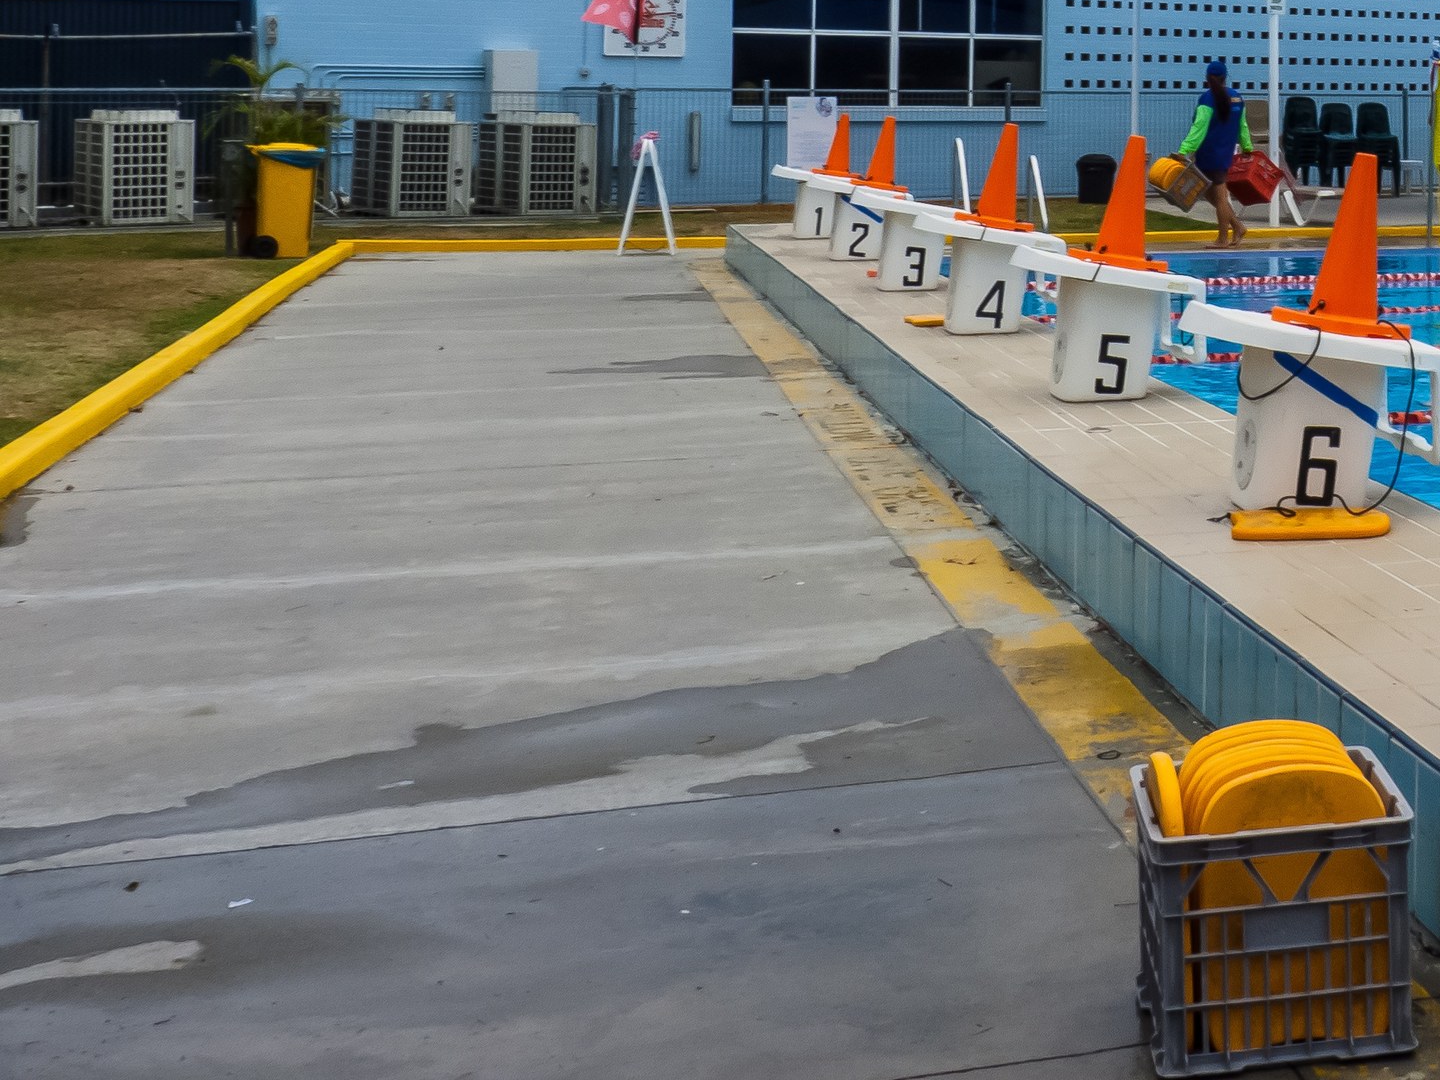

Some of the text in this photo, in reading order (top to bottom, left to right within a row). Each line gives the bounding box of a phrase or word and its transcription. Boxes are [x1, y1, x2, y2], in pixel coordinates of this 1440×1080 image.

[814, 206, 823, 236] 1
[848, 222, 870, 258] 2
[902, 246, 927, 287] 3
[975, 280, 1006, 329] 4
[1094, 333, 1131, 395] 5
[1294, 425, 1341, 507] 6
